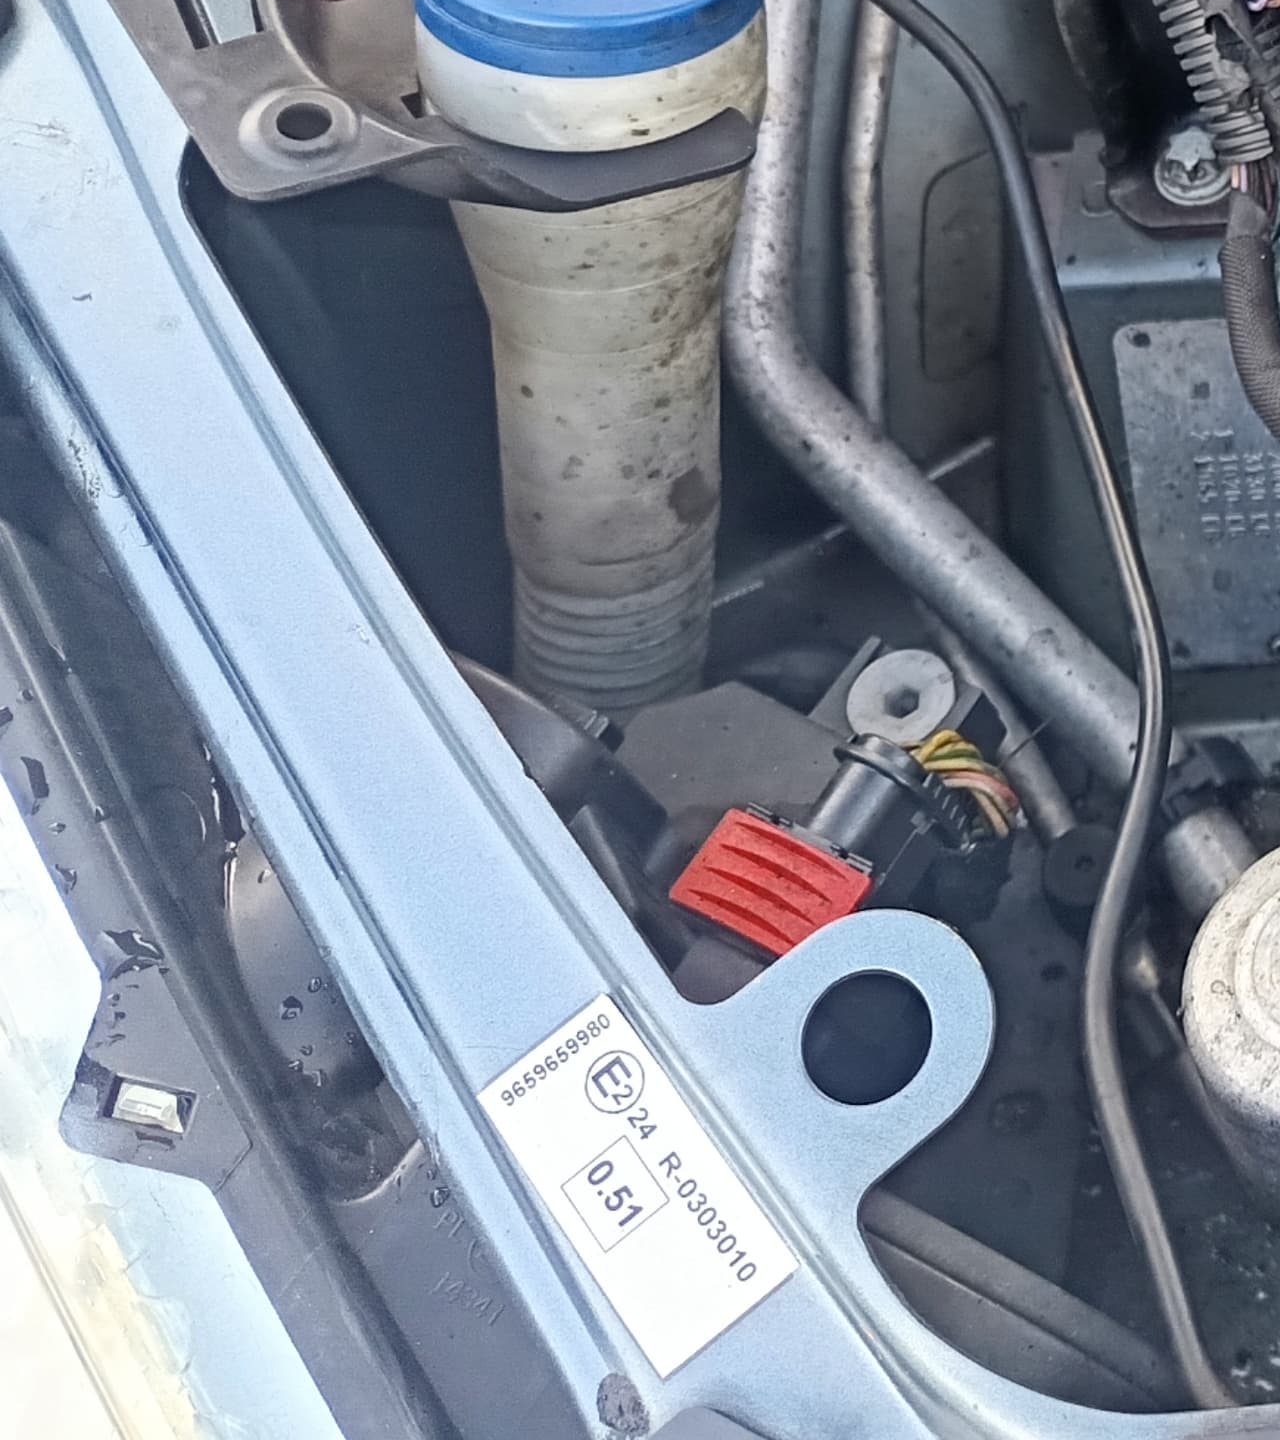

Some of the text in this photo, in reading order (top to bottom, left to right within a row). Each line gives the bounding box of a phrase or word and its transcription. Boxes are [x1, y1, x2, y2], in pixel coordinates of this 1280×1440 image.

[501, 1013, 611, 1106] 9659659980
[587, 1160, 644, 1227] 0.51
[628, 1107, 658, 1140] 24
[659, 1151, 757, 1282] R-0303010
